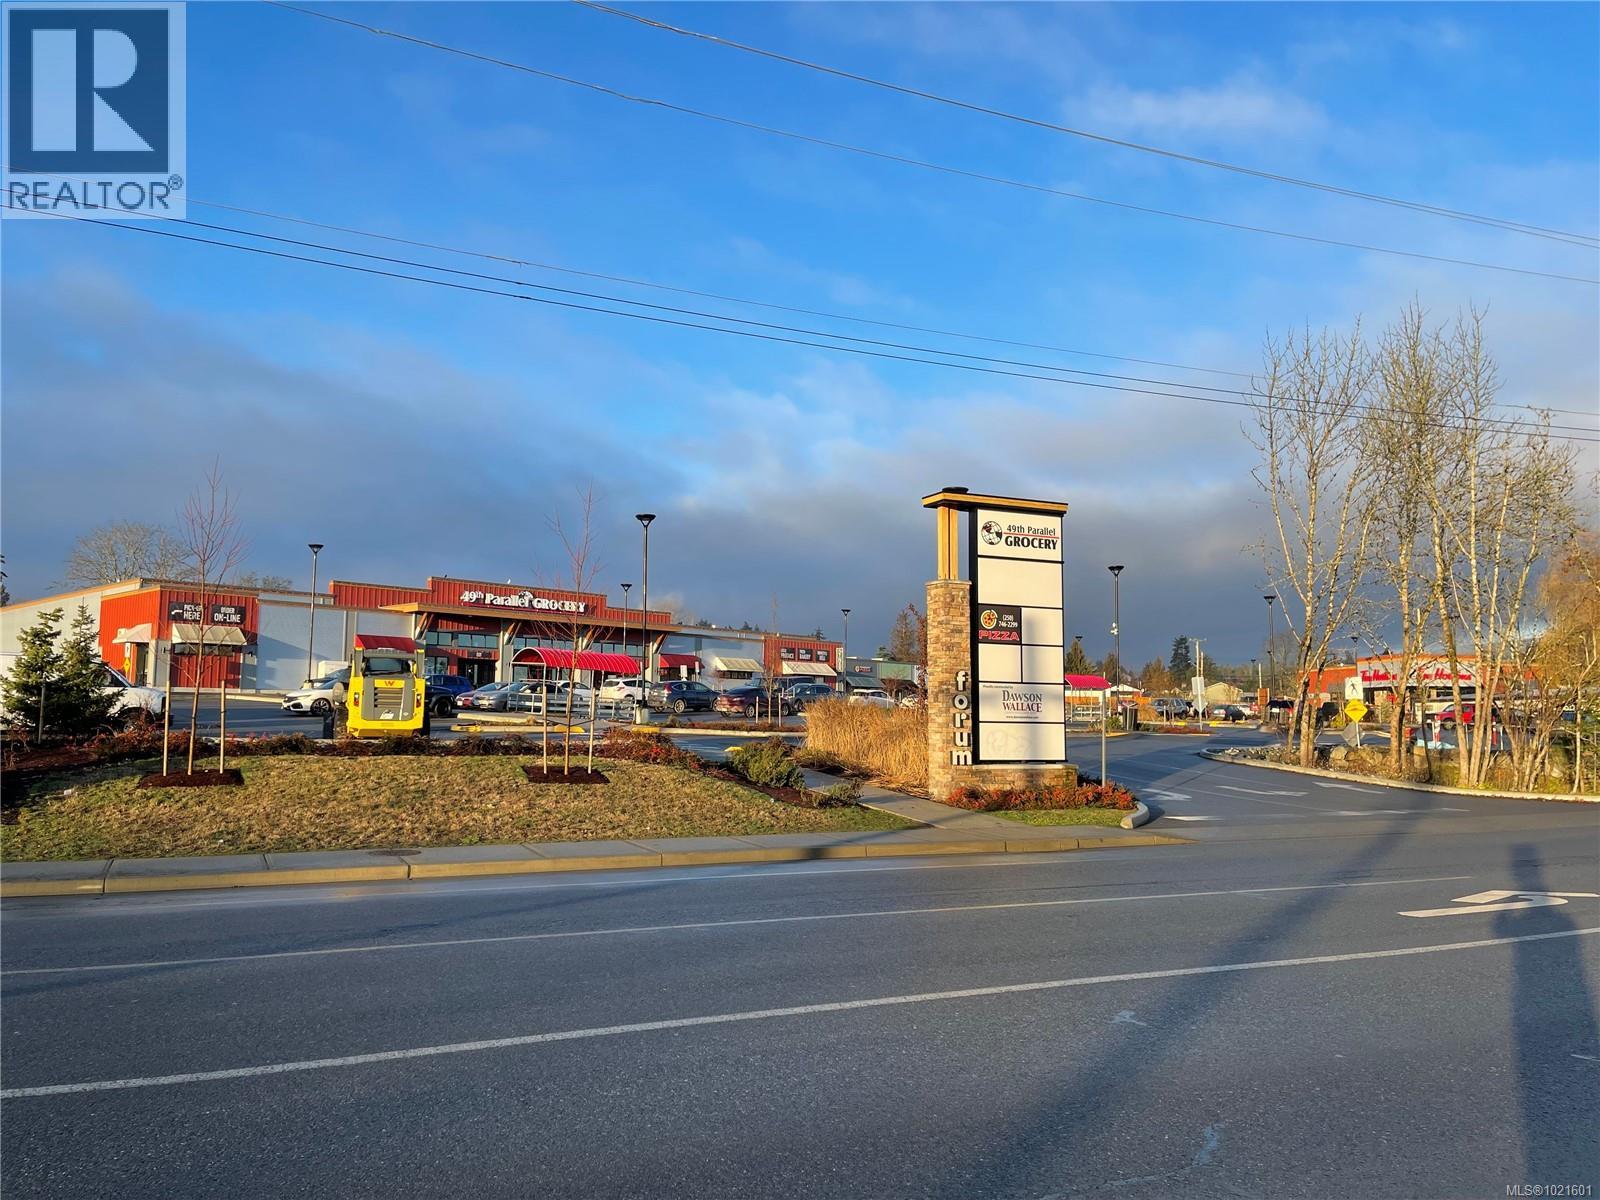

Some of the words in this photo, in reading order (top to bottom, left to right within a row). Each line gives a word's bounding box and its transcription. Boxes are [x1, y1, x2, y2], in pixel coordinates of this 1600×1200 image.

[1006, 524, 1025, 533] 49th
[1027, 526, 1056, 536] Parallel
[1004, 535, 1058, 550] GROCERY
[460, 590, 484, 602] 49th
[485, 592, 529, 607] Parallel
[183, 611, 200, 620] HERE
[214, 613, 241, 622] ON-LINE
[979, 630, 1019, 641] PIZZA
[1002, 689, 1042, 702] DAWSON
[1002, 702, 1042, 713] WALLACE
[951, 670, 972, 766] forum
